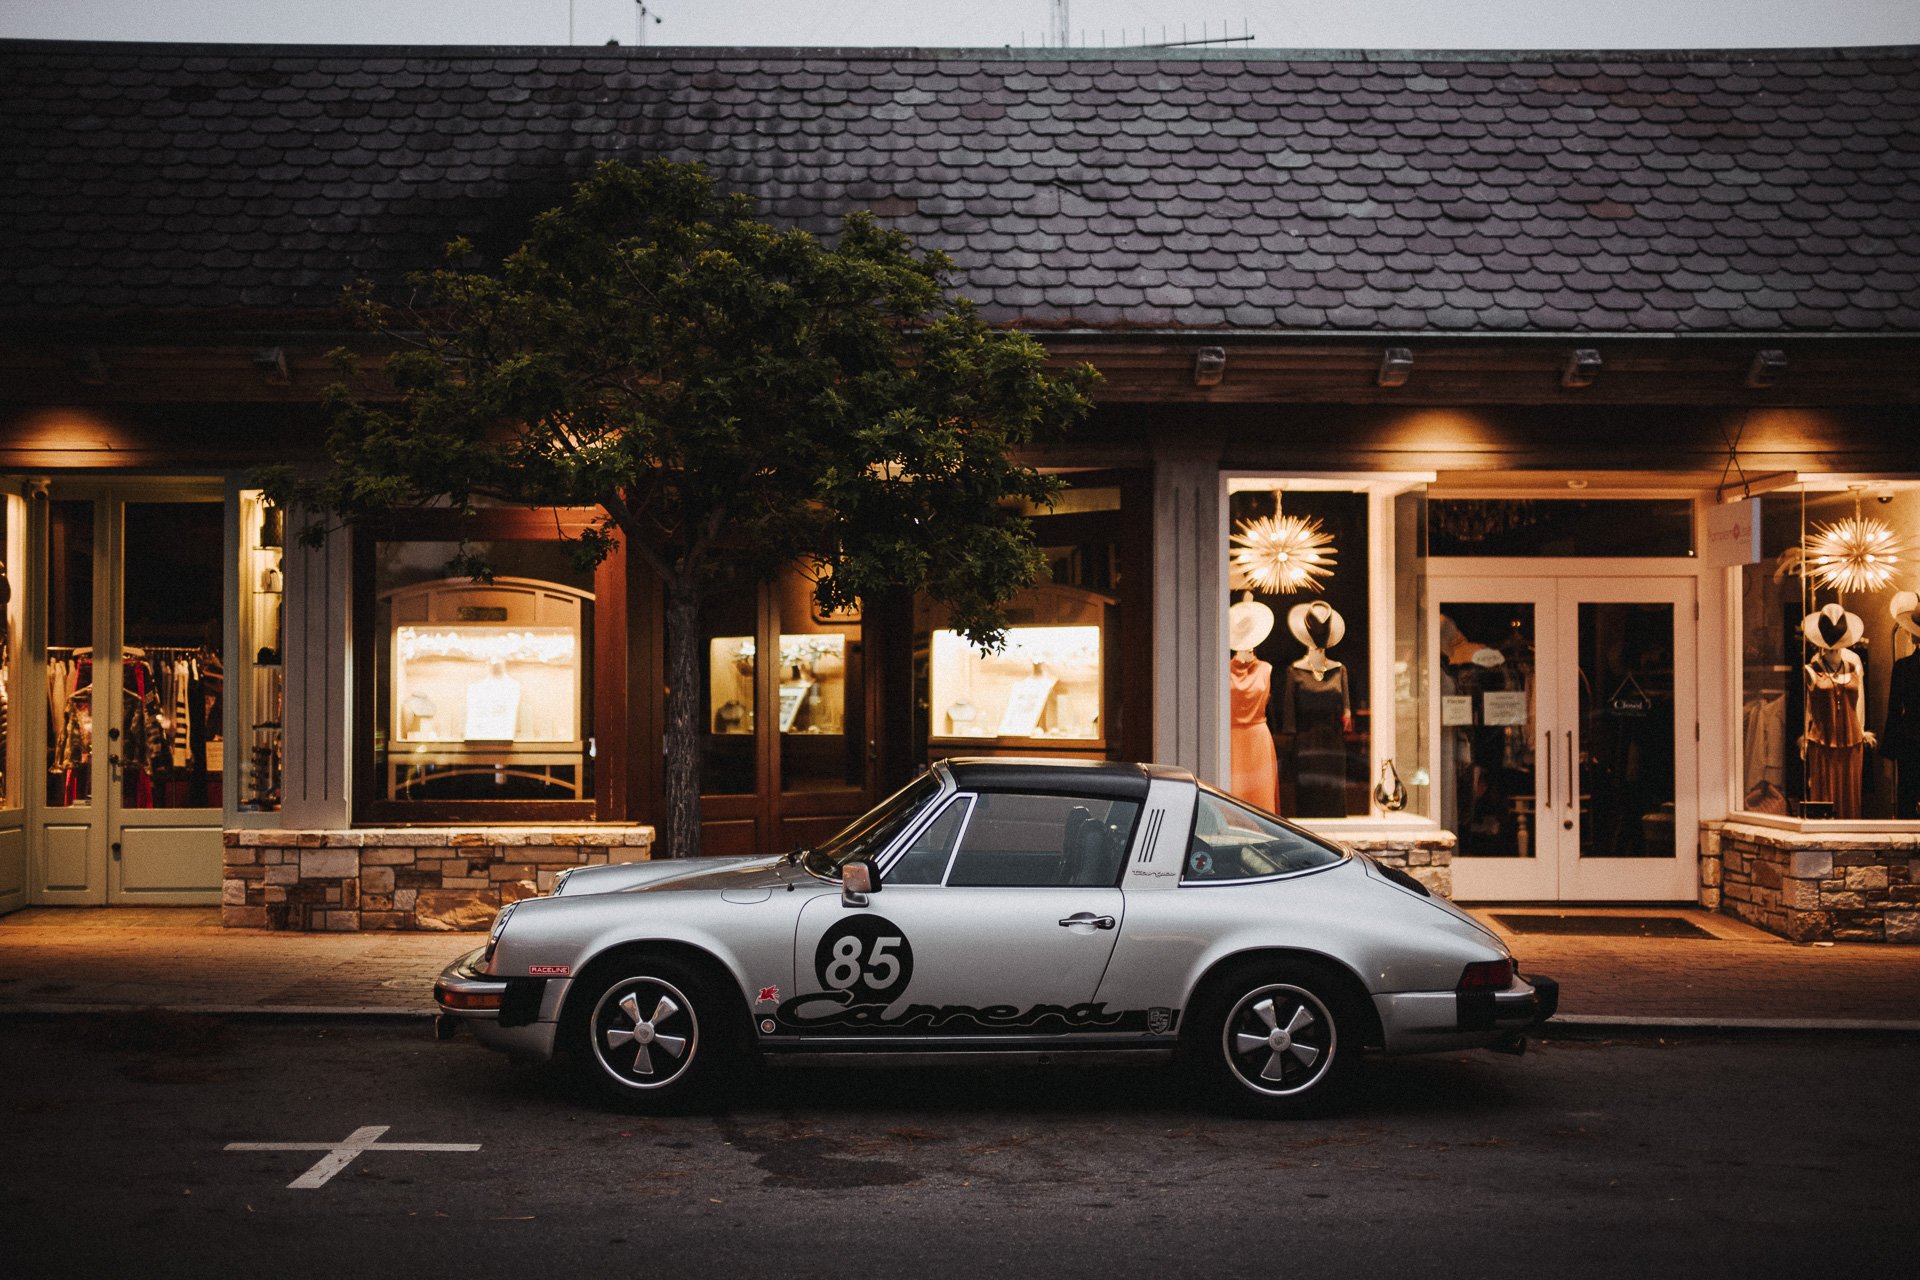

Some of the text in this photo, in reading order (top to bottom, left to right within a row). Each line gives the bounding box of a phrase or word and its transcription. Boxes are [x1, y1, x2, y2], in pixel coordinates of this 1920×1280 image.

[530, 966, 568, 974] RACELINE
[825, 935, 902, 990] 85
[776, 989, 1124, 1027] Carrera
